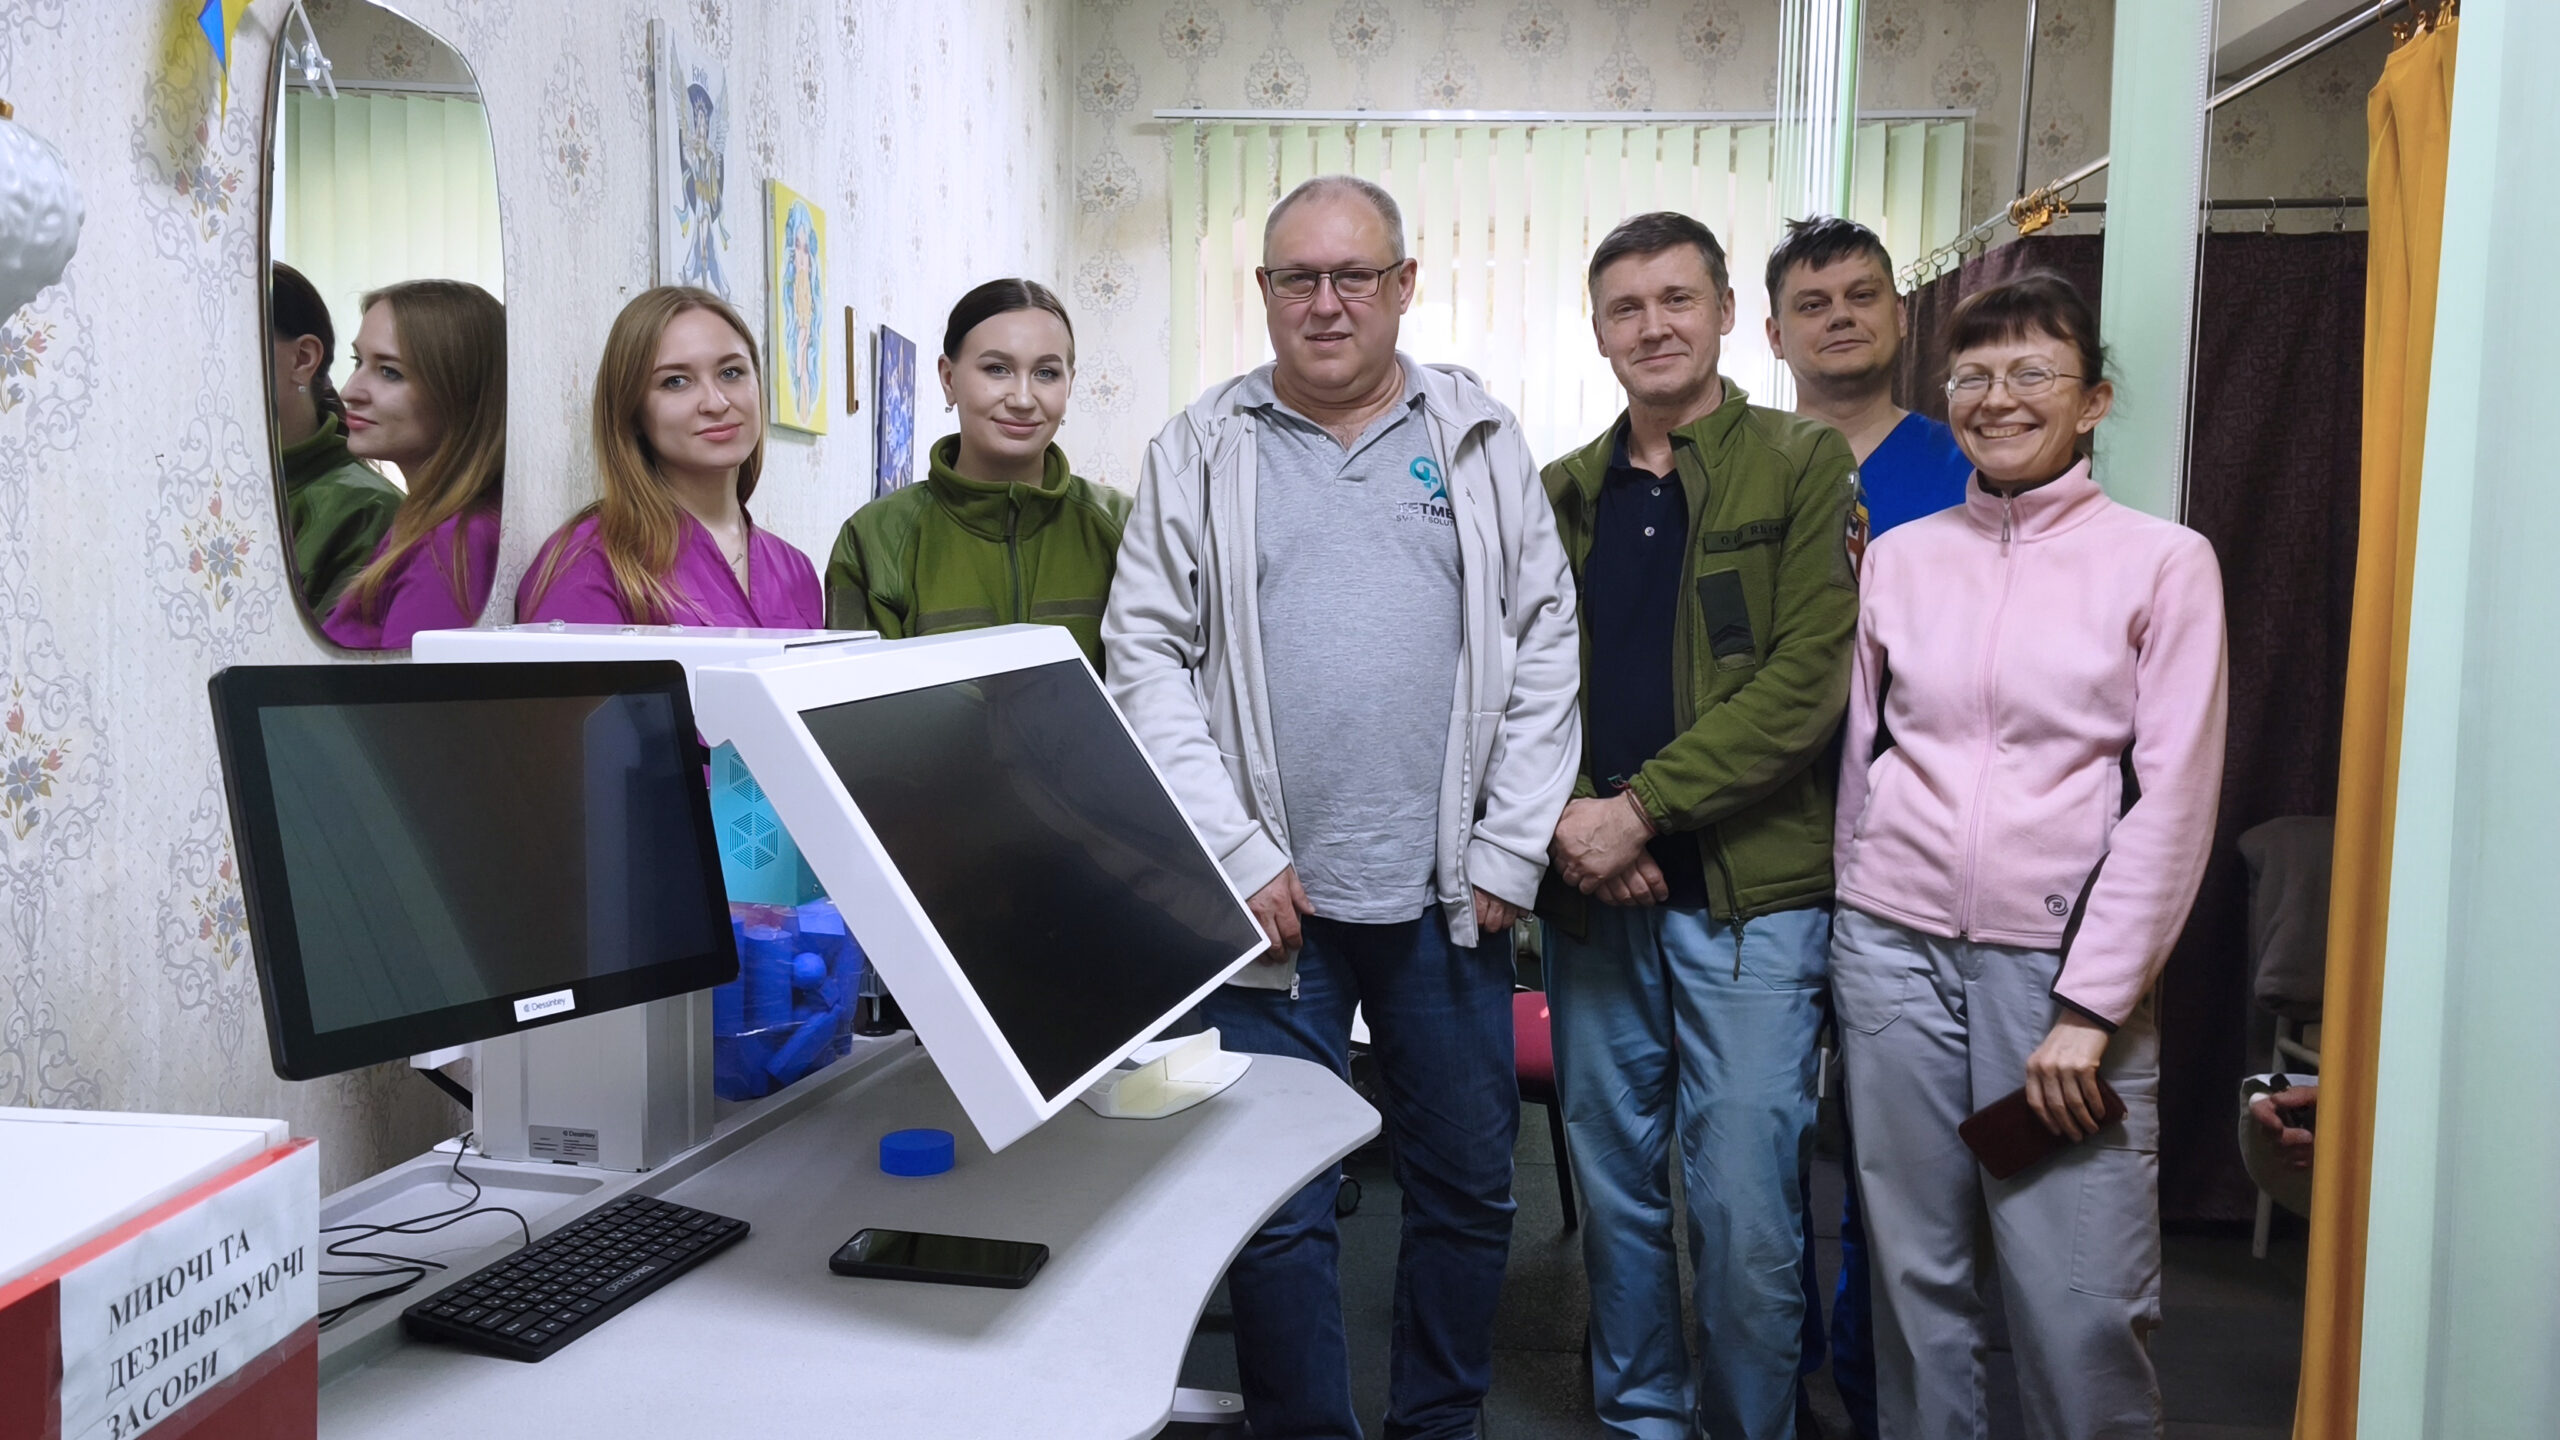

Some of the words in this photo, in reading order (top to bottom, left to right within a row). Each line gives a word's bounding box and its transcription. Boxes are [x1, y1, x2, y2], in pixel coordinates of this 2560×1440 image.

[105, 1245, 305, 1400] ДЕЗІНФІКУЮЧІ
[108, 1246, 214, 1336] МИЮЧІ
[219, 1228, 251, 1268] ТА
[106, 1348, 219, 1440] ЗАСОБИ
